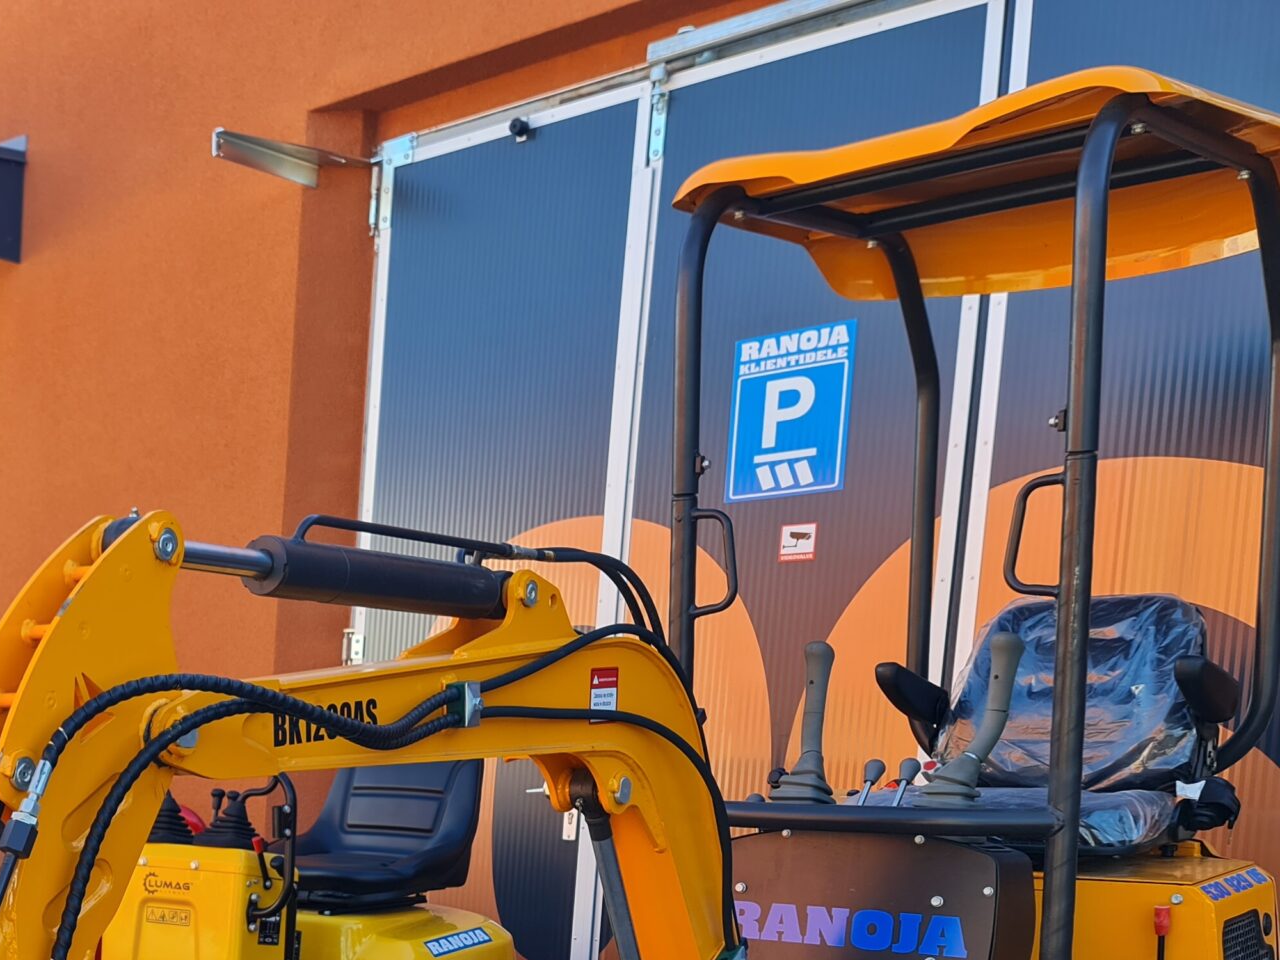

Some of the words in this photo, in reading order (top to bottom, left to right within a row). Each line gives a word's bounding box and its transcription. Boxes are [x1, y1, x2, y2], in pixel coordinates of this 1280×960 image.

[740, 325, 849, 362] RANOJA
[739, 346, 848, 375] KLIENTIDELE
[762, 376, 815, 449] P
[146, 877, 190, 891] LUMAG
[426, 929, 490, 955] RANOJA
[734, 900, 968, 958] RANOJA
